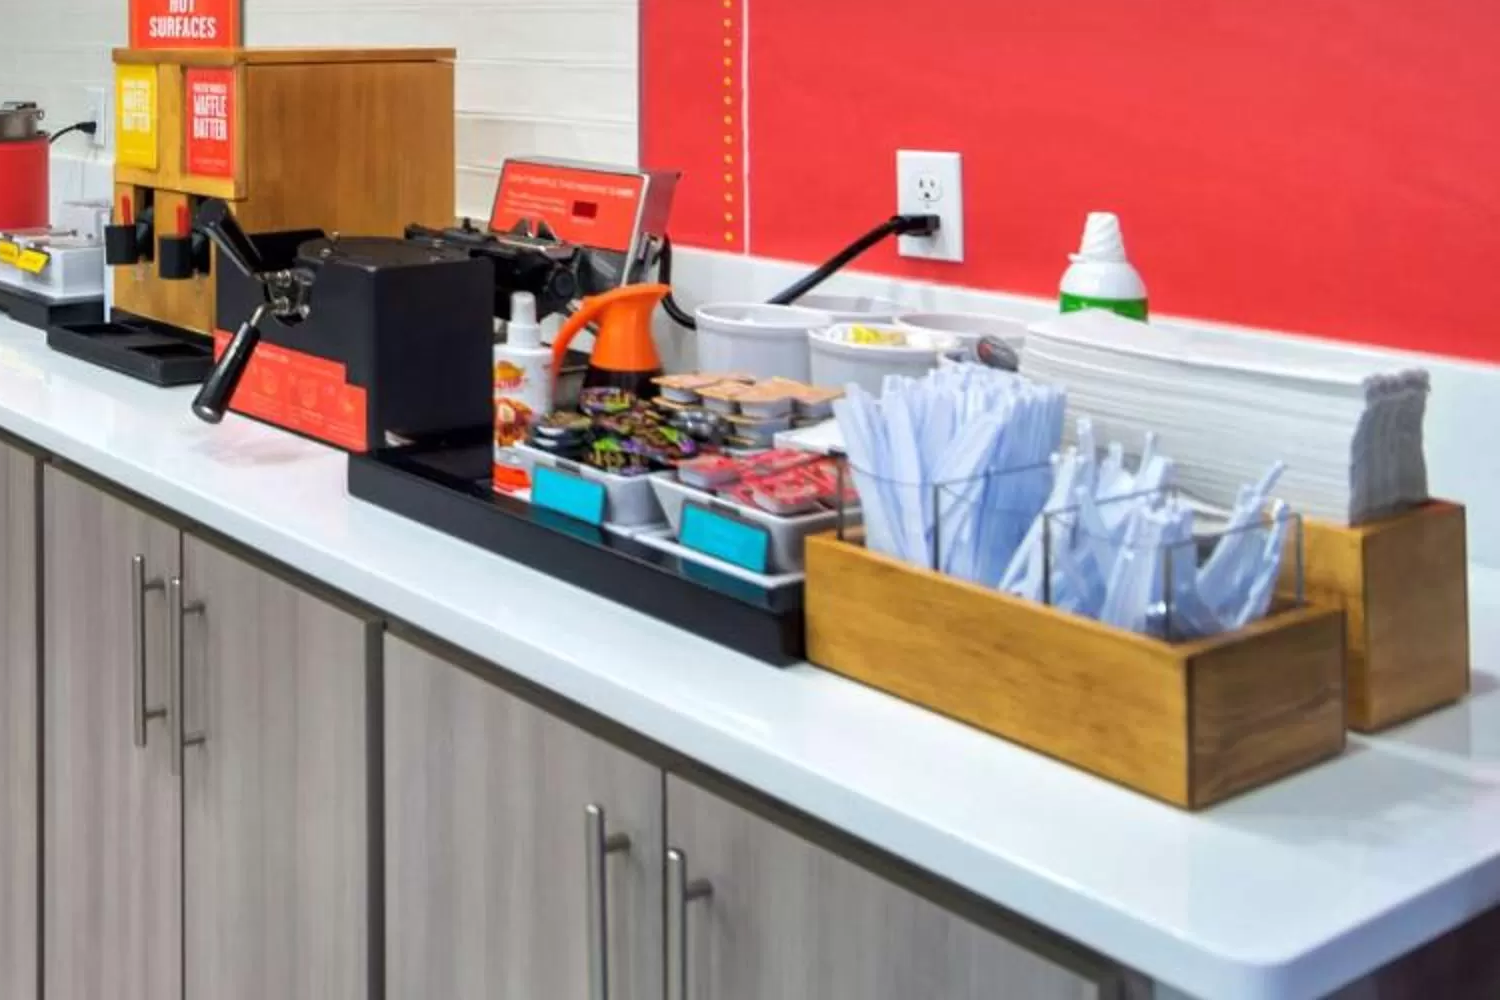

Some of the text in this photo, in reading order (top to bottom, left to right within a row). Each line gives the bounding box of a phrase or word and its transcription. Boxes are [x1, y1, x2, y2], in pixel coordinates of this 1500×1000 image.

[148, 15, 217, 39] SURFACES
[193, 94, 228, 117] WAFFLE
[193, 117, 228, 141] BATTER
